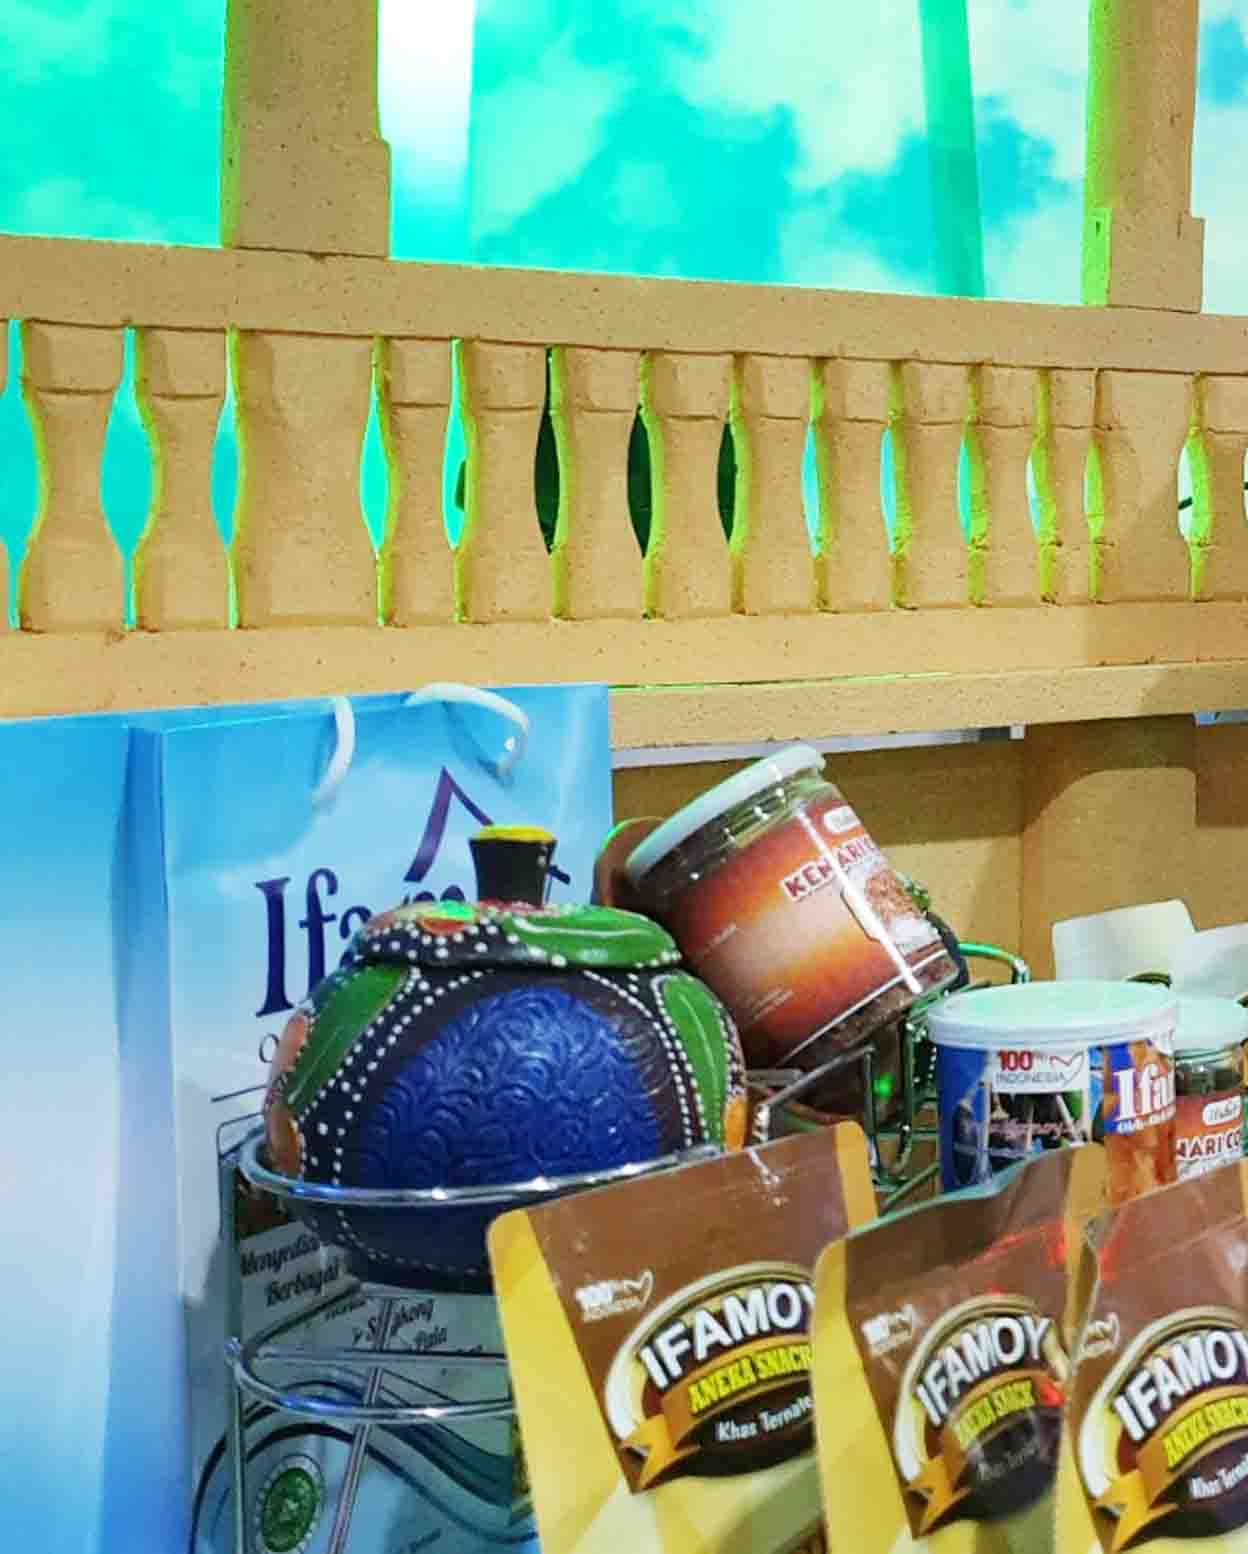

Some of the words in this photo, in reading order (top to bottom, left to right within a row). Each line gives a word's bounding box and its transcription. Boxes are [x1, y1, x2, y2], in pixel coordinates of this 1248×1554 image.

[688, 1354, 757, 1415] ANEKA
[915, 1314, 1050, 1416] IFAMOY
[716, 1420, 757, 1441] Khas
